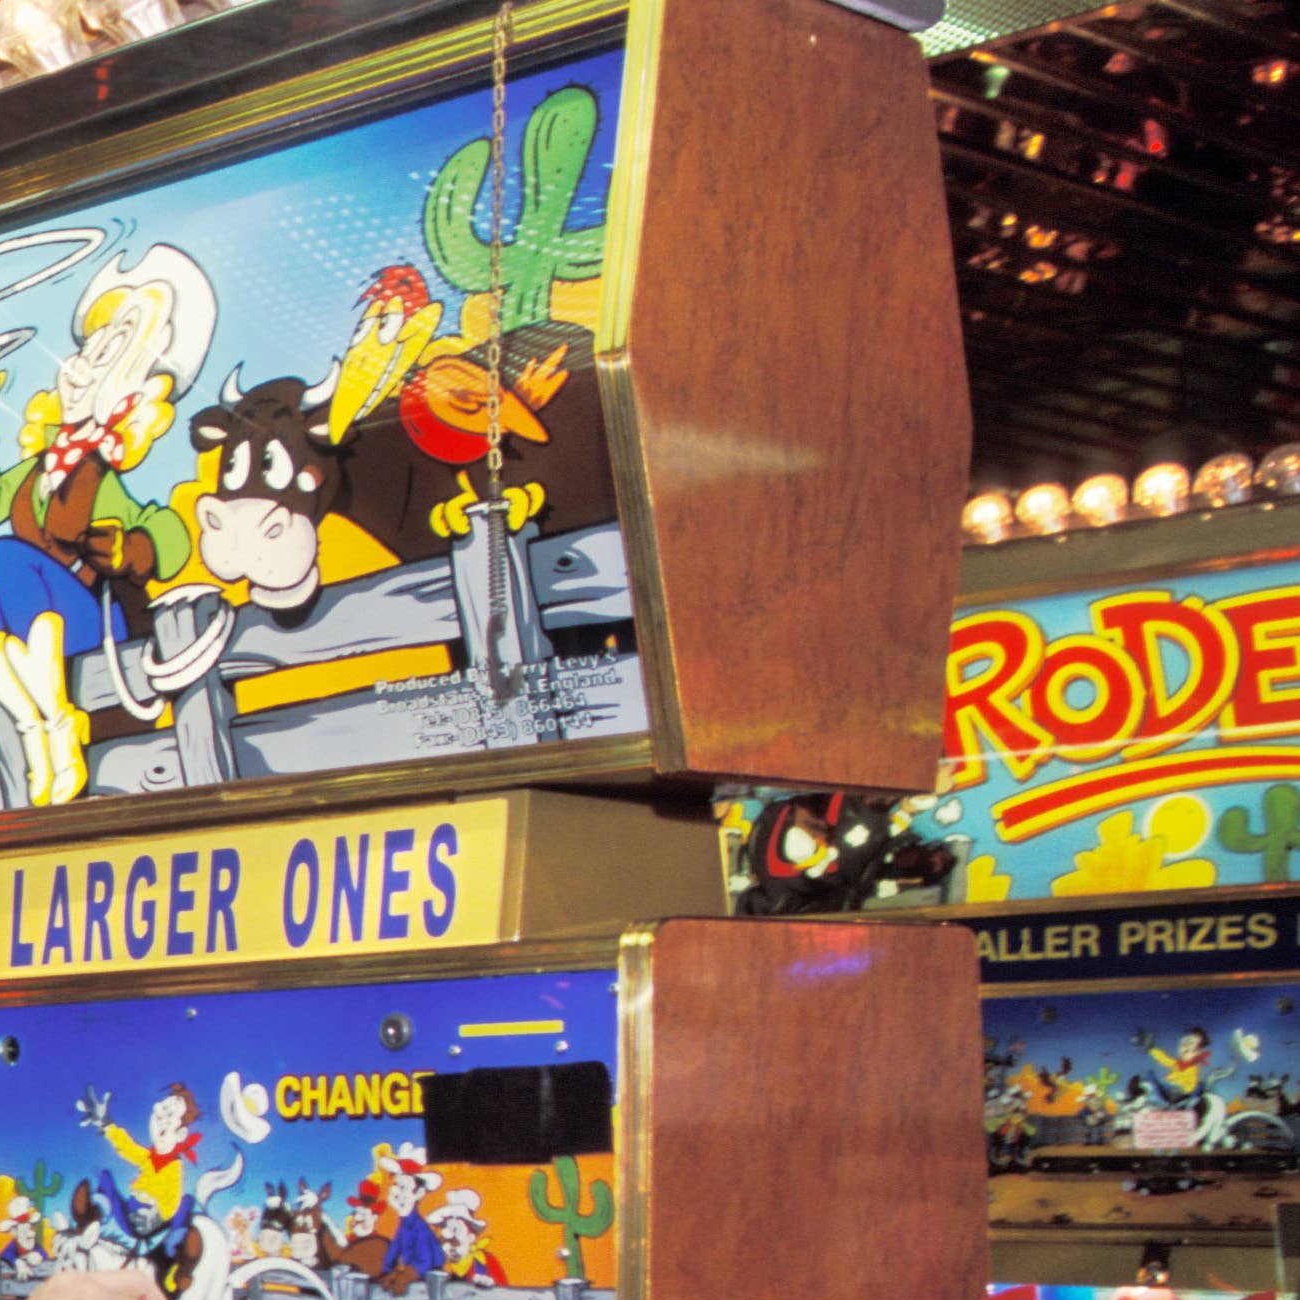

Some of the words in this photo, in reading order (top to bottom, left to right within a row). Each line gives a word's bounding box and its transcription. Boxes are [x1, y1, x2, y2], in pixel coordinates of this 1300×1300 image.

[9, 847, 242, 968] LARGER
[282, 821, 459, 949] ONES
[1117, 912, 1278, 956] PRIZES
